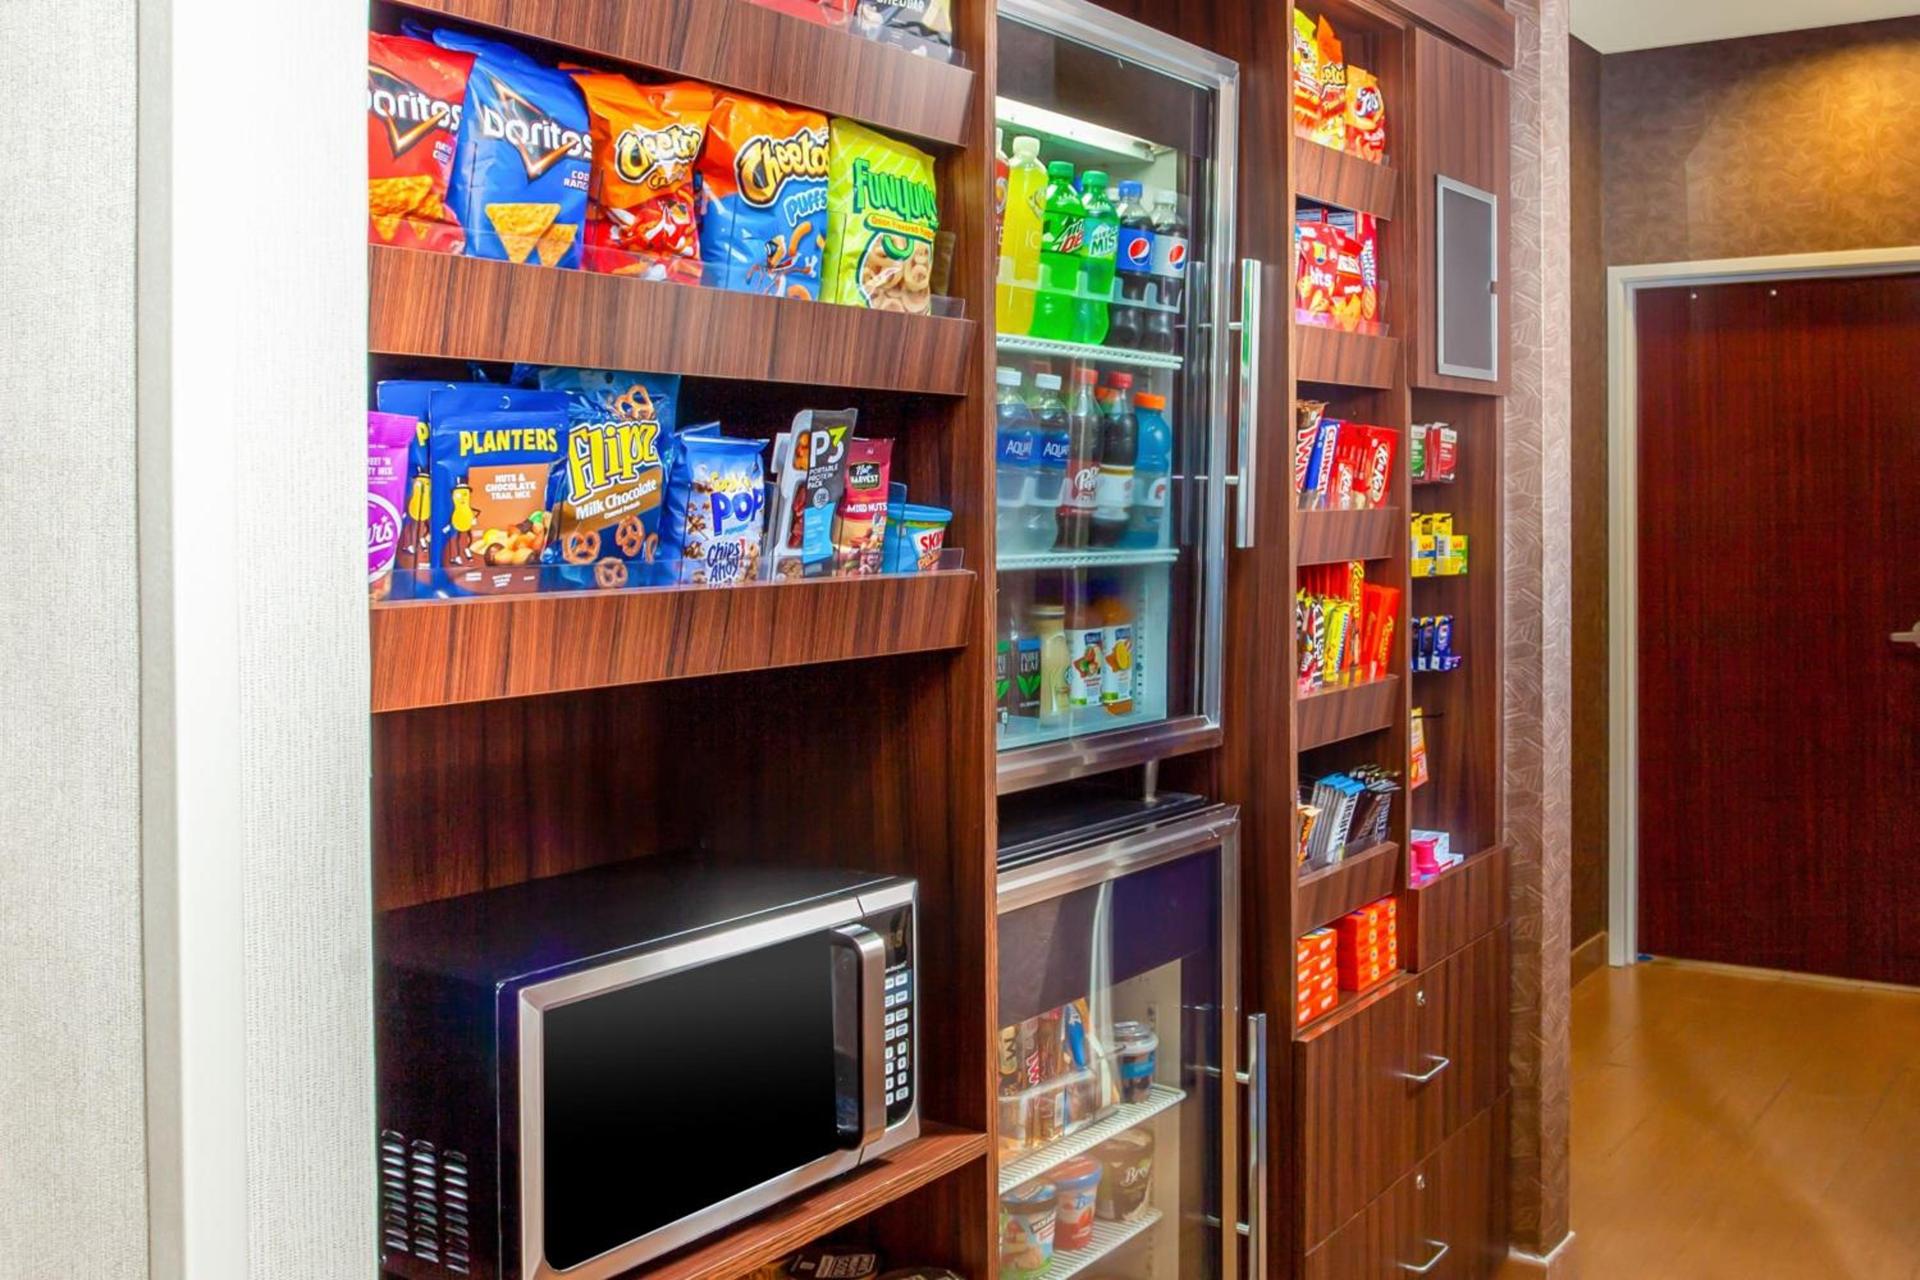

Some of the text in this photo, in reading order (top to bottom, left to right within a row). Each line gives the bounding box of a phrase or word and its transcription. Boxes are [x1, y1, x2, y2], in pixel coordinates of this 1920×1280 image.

[482, 104, 592, 160] Doritos
[459, 427, 558, 457] PLANTERS
[810, 463, 838, 475] PORTABLE
[808, 472, 833, 483] PROTEIN
[485, 481, 537, 493] CHOCOLATE
[807, 480, 823, 490] PACK
[514, 490, 531, 499] MIX
[576, 479, 657, 520] Milk Chocolate
[710, 488, 764, 536] POP
[868, 501, 888, 512] NUTS
[707, 540, 740, 567] Chips
